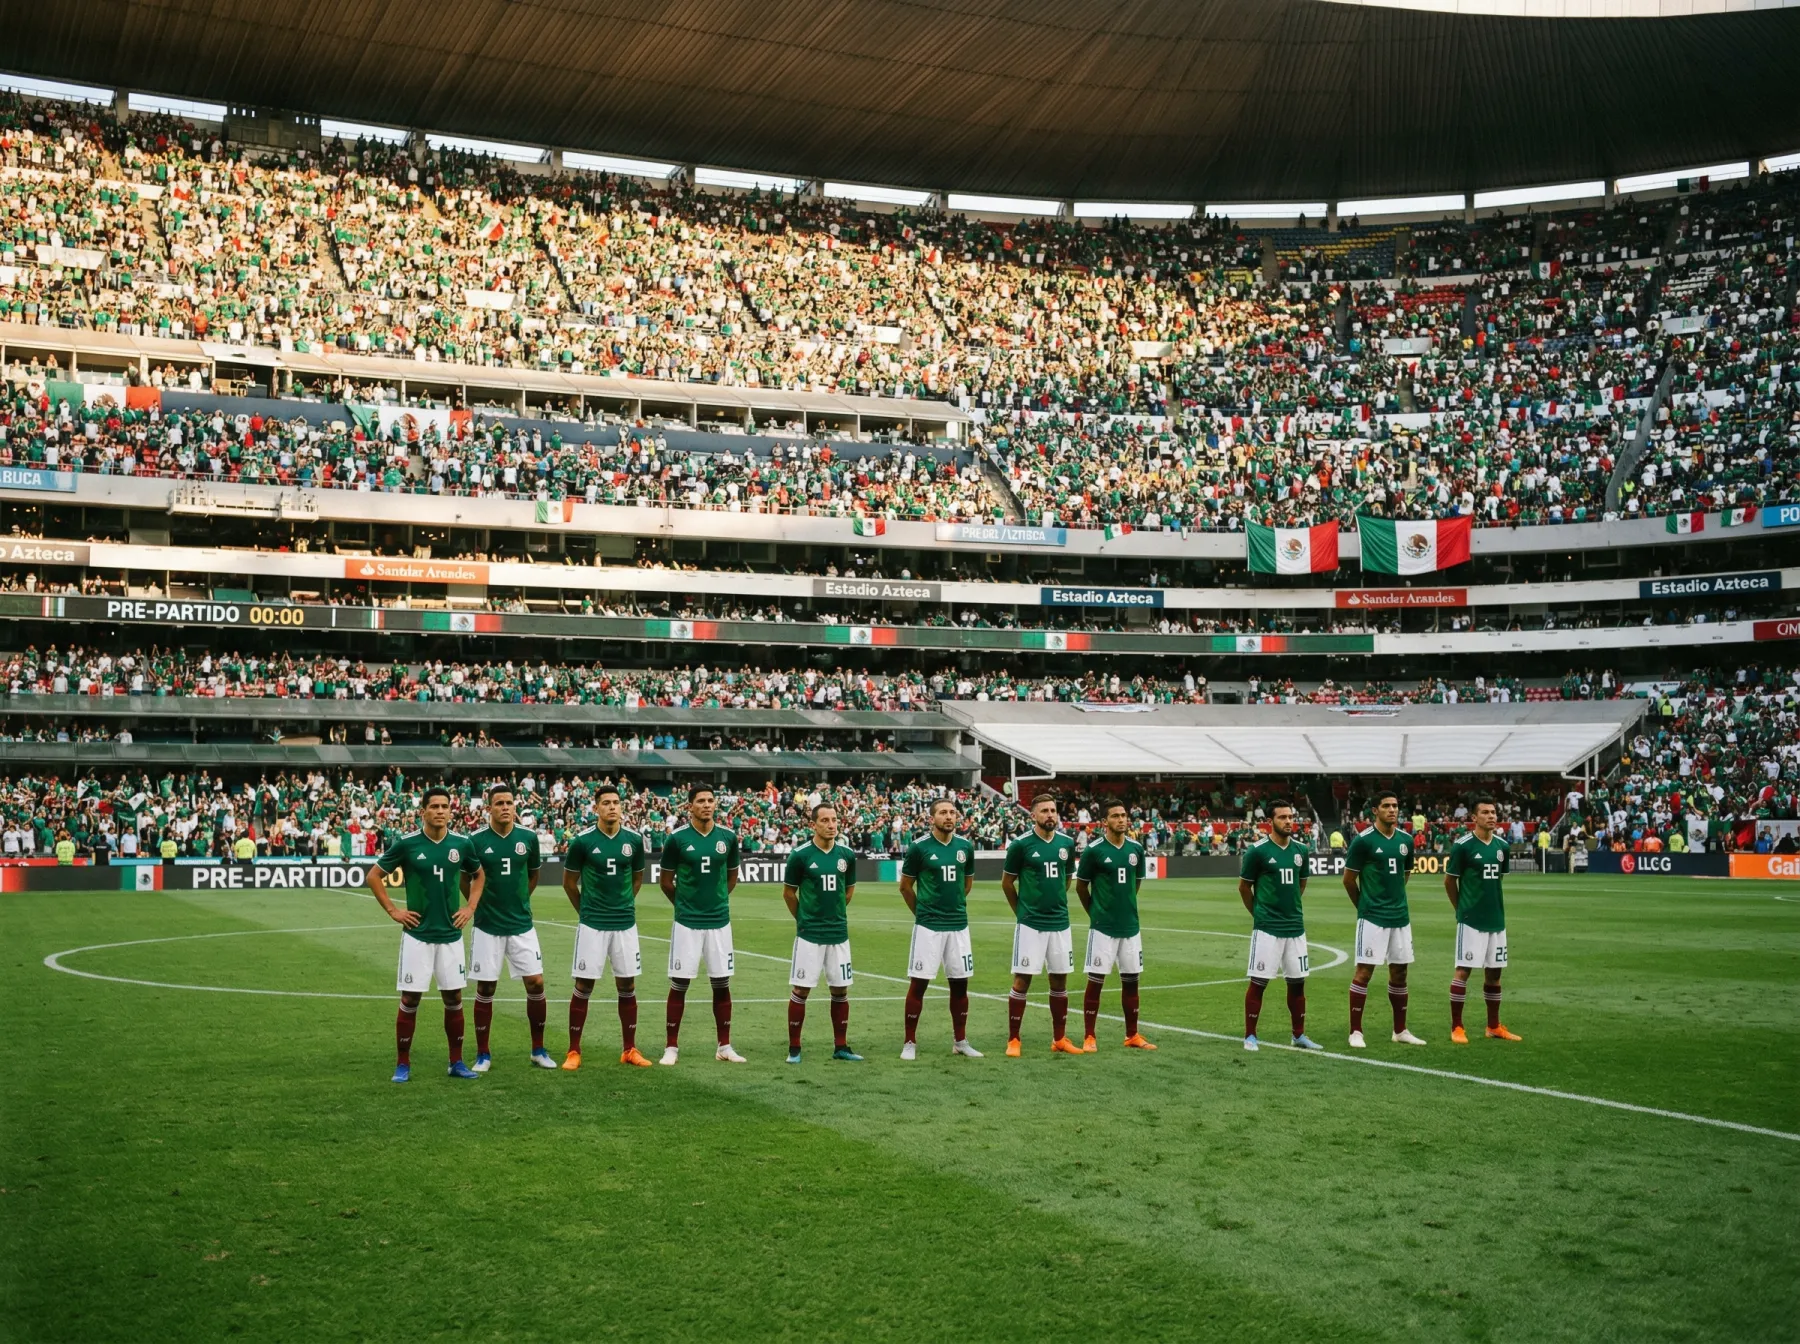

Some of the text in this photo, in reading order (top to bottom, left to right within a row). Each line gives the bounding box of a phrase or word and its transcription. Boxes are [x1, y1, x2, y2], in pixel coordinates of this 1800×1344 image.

[0, 470, 42, 485] BUCA
[10, 545, 75, 561] Azteca
[825, 582, 931, 598] Estadio Azteca
[1651, 577, 1769, 595] Estadio Azteca
[1052, 590, 1154, 604] Estadio Azteca
[107, 601, 304, 625] PRE-PARTIDO 00:00
[501, 857, 511, 875] 3
[606, 858, 617, 876] 5
[701, 856, 711, 873] 2
[1044, 861, 1058, 878] 16
[1388, 858, 1397, 874] 9
[1483, 863, 1499, 879] 22
[192, 866, 364, 888] PRE-PARTIDO
[433, 865, 444, 882] 4
[941, 865, 956, 882] 16
[1118, 867, 1127, 883] 8
[1279, 868, 1294, 885] 10
[820, 874, 837, 891] 18
